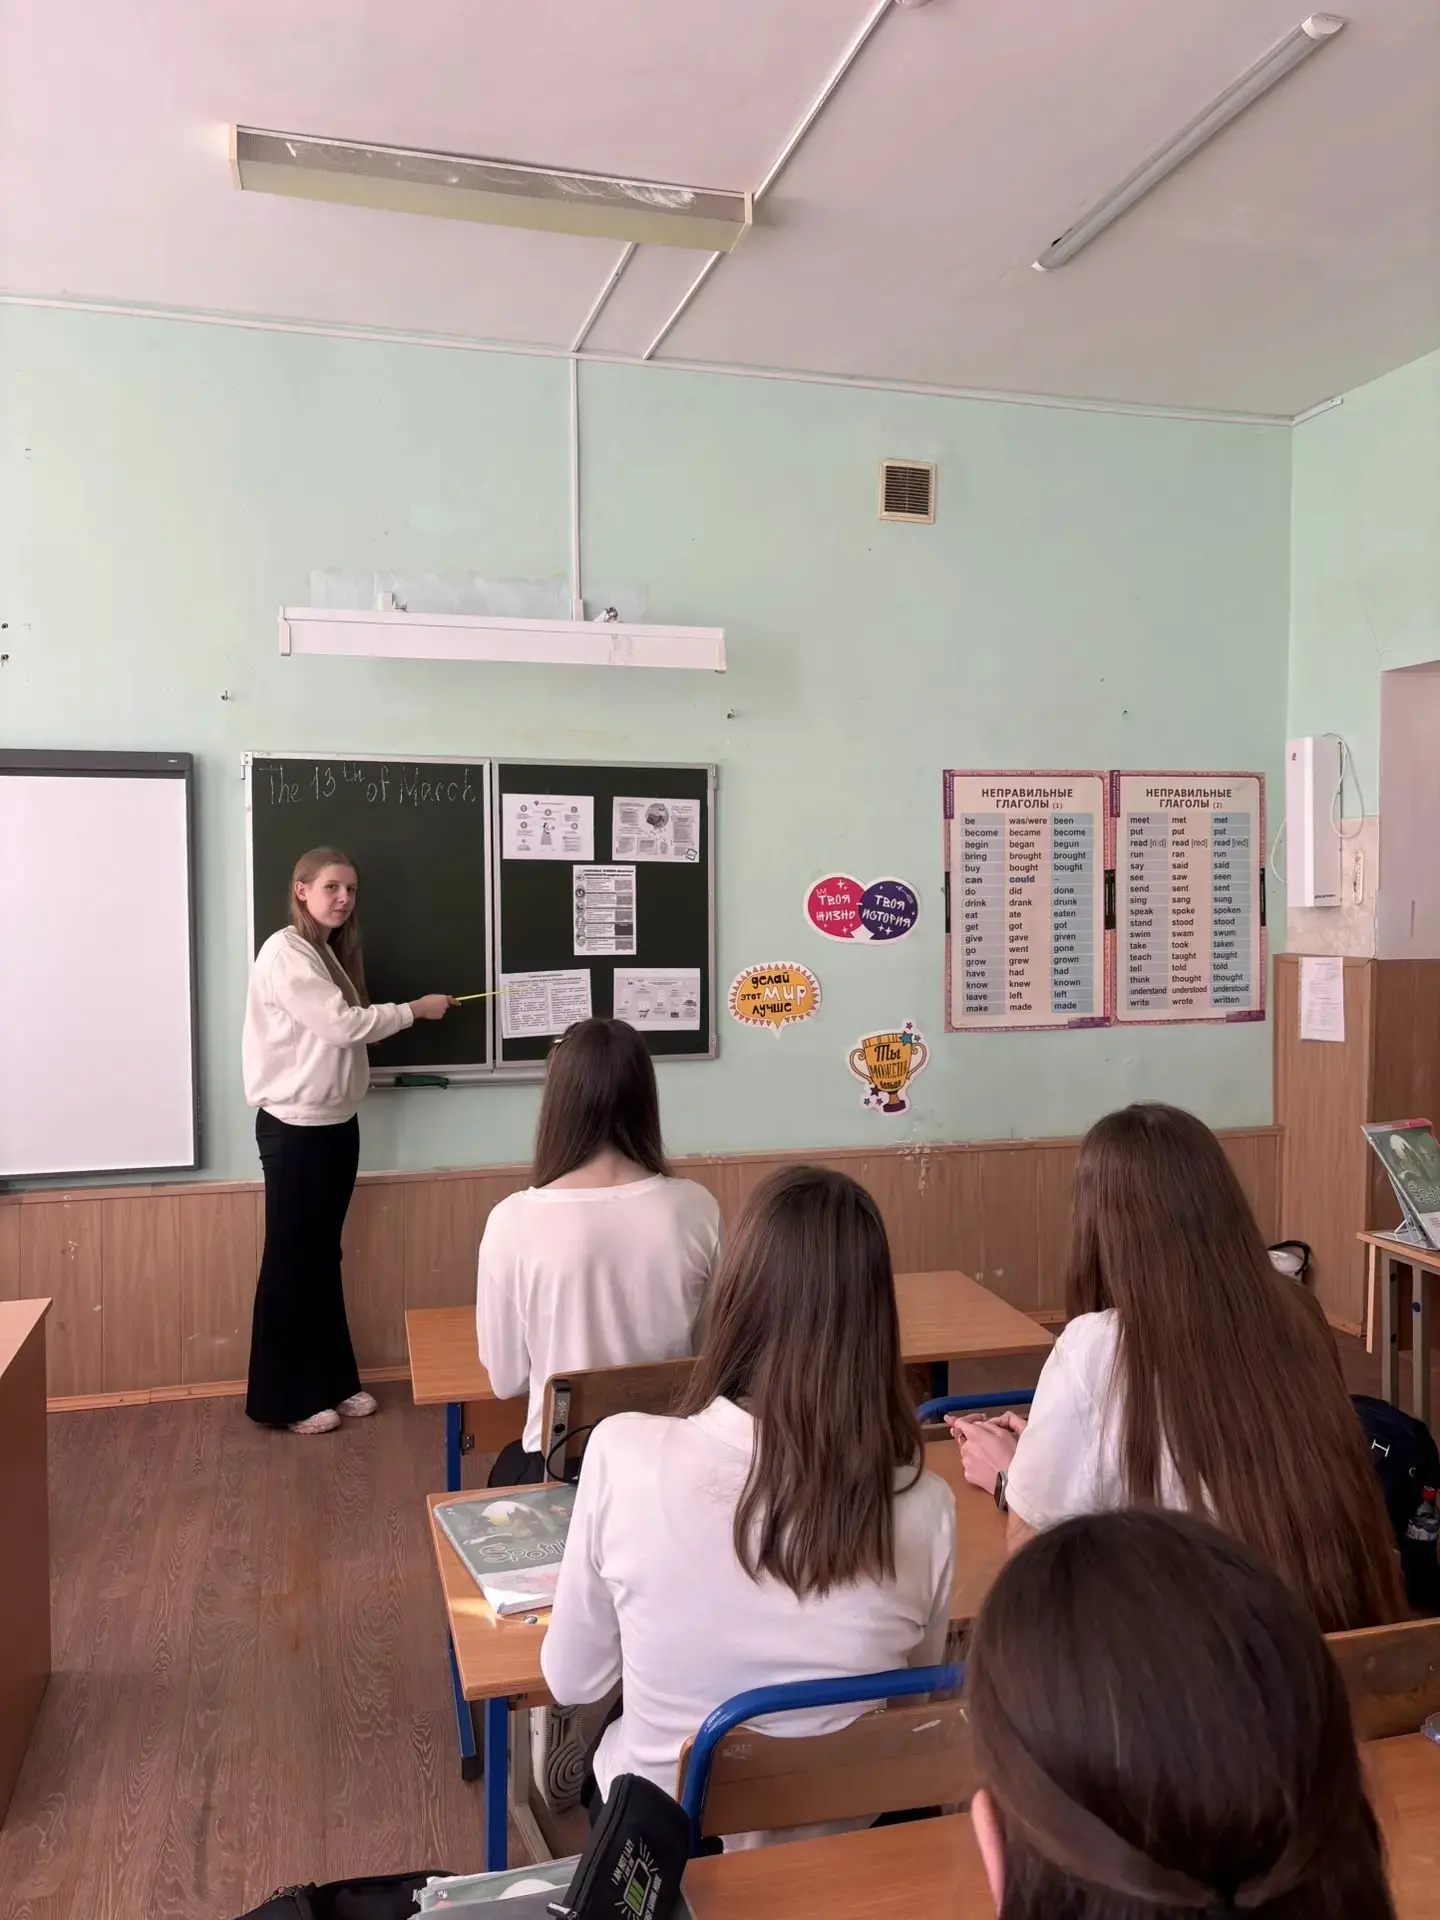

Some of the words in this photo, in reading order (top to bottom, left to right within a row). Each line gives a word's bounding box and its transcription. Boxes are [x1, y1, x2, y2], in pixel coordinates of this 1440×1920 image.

[259, 765, 302, 804] The
[367, 765, 390, 802] of
[400, 766, 476, 806] March
[982, 788, 1073, 797] НЕПРАВИЛЬНЫЕ
[1146, 789, 1232, 797] НЕПРАВИЛЬНЫЕ
[996, 799, 1049, 808] ГЛАГОЛЫ
[1160, 800, 1209, 808] ГЛАГОЛЫ
[1130, 828, 1143, 837] put
[1172, 828, 1185, 836] put
[1214, 828, 1226, 836] put
[965, 841, 988, 850] begin
[1009, 841, 1034, 849] began
[1054, 840, 1079, 848] begun
[965, 853, 987, 862] bring
[1009, 853, 1041, 861] brought
[1054, 852, 1086, 860] brought
[965, 865, 980, 873] buy
[1009, 864, 1038, 872] bought
[1054, 863, 1082, 871] bought
[818, 894, 850, 905] ТВОЯ
[875, 895, 905, 911] ТВОЯ
[1130, 897, 1147, 905] sing
[1172, 897, 1191, 905] sang
[1214, 896, 1232, 904] sung
[816, 910, 856, 921] ЖИЗНЬ
[1130, 908, 1153, 916] speak
[1172, 907, 1195, 916] spoke
[1214, 907, 1241, 915] spoken
[862, 909, 911, 927] ИСТОРИЯ
[965, 935, 983, 944] give
[1054, 933, 1076, 941] given
[966, 959, 986, 967] grow
[752, 972, 789, 988] делай
[1172, 975, 1201, 983] thought
[1213, 974, 1243, 982] thought
[966, 981, 988, 989] know
[752, 1003, 791, 1017] лучше
